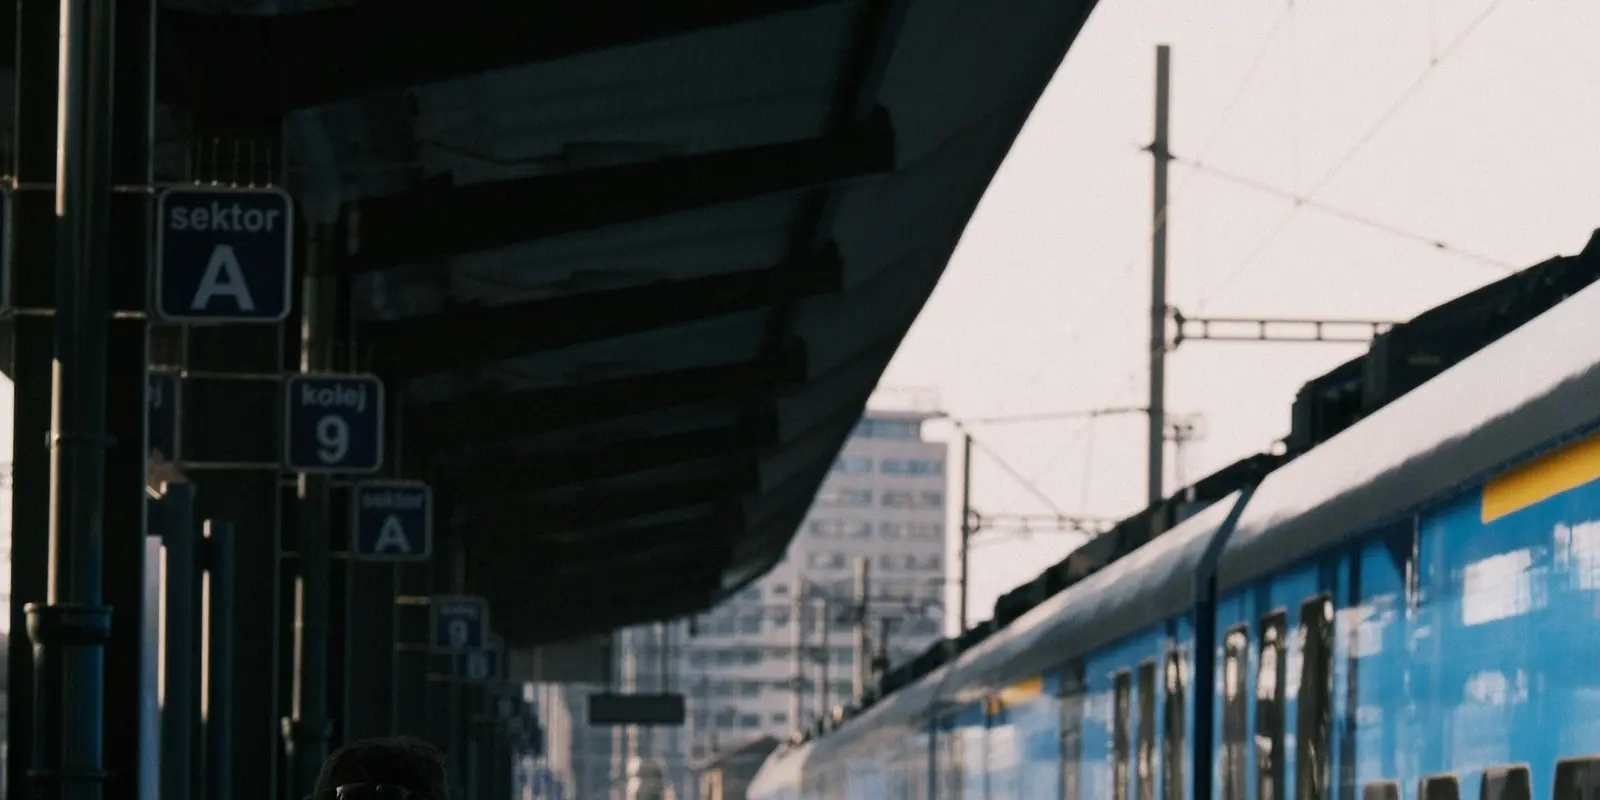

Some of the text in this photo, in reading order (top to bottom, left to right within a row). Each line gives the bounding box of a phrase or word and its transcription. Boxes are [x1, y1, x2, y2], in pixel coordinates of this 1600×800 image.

[169, 201, 280, 233] sektor
[190, 244, 256, 311] A
[301, 382, 367, 413] kolej
[315, 413, 351, 464] 9
[375, 513, 412, 553] A
[449, 619, 468, 648] 9
